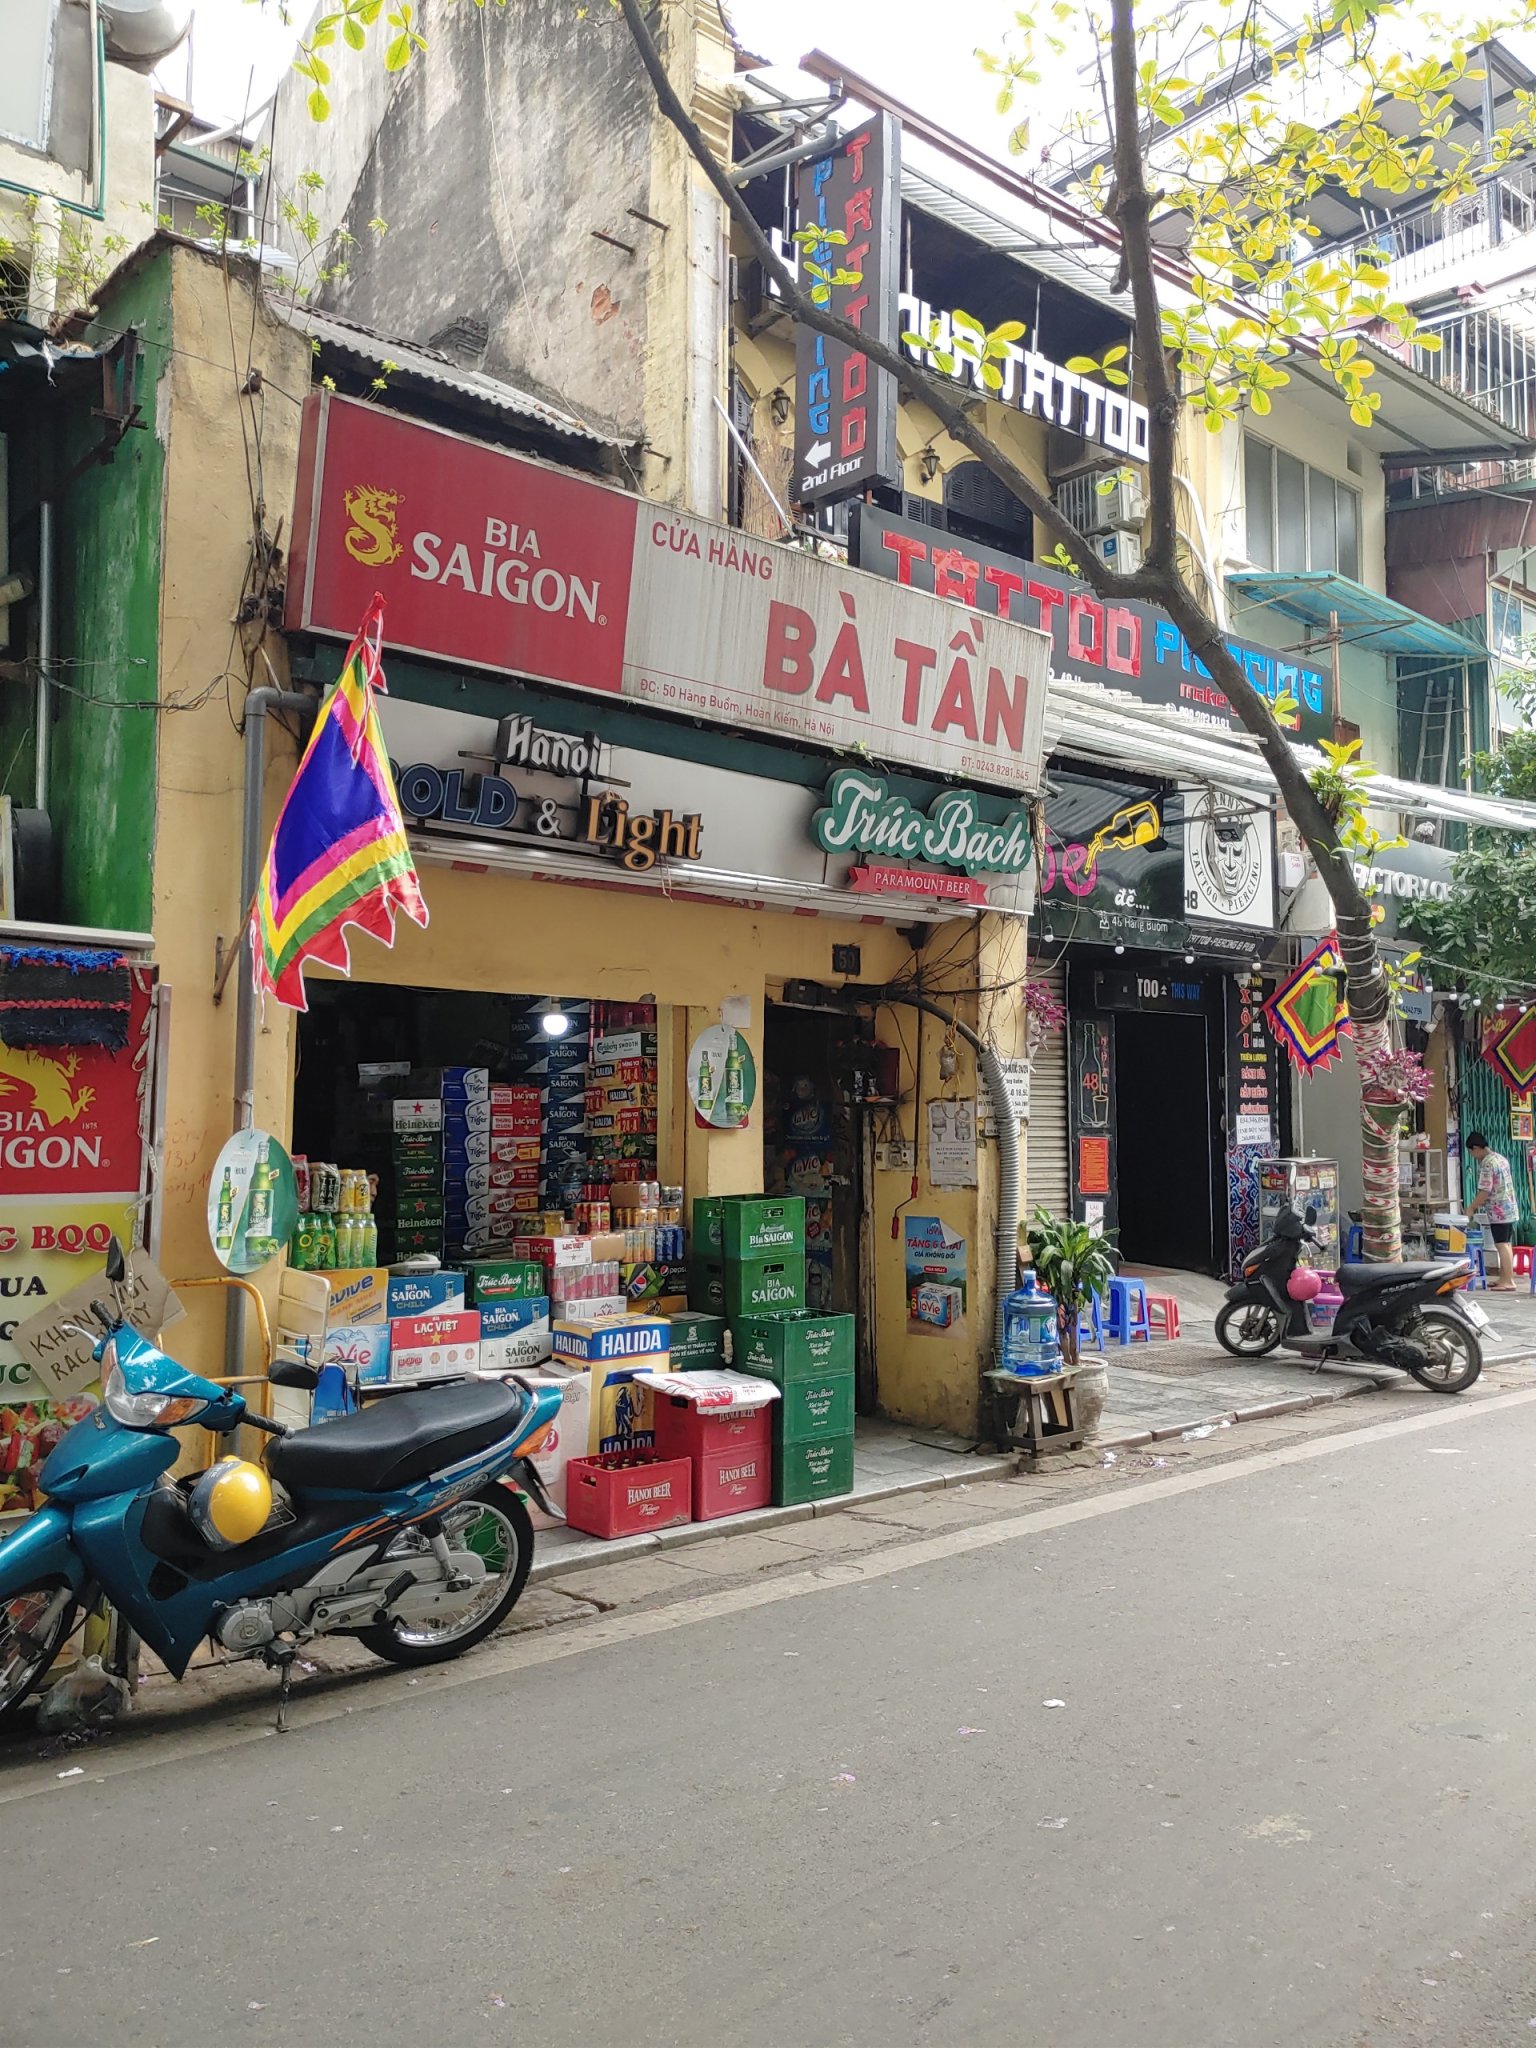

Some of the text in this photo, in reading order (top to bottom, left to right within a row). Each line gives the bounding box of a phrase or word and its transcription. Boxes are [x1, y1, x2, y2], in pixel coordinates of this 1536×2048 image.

[841, 132, 872, 459] TATTOO
[1003, 340, 1149, 462] TATTOO
[802, 456, 864, 491] 2nd Floor
[484, 516, 541, 559] BIA
[652, 517, 774, 580] CỬA HÀNG
[410, 531, 602, 624] SAIGON
[881, 529, 1142, 678] TATTOO
[763, 590, 1029, 754] BÀ TẦN
[640, 678, 835, 736] ĐC: 50 Hàng Buồm, Hoàn Kiếm, Hà Nội
[504, 713, 601, 777] Hanoi
[961, 756, 975, 768] ĐT:
[391, 758, 705, 872] OLD & Light
[824, 777, 1028, 875] Trúc Bạch
[873, 871, 971, 895] PARAMOUNT BEER
[1192, 848, 1259, 911] TATTOO PIERCING
[1353, 863, 1430, 899] ACTORY
[839, 950, 856, 970] 50
[1137, 979, 1201, 1000] TOO THIS WAY
[618, 1040, 639, 1049] SMOOTH
[469, 1084, 485, 1094] Tiger
[1082, 1073, 1098, 1089] 48
[0, 1111, 98, 1132] BIA 1875
[471, 1116, 487, 1126] Tiger
[550, 1110, 577, 1118] SAIGON
[395, 1119, 440, 1129] Heineken
[471, 1149, 486, 1159] Tiger
[470, 1179, 486, 1189] Tiger
[397, 1217, 442, 1228] Heineken
[470, 1211, 486, 1221] Tiger
[31, 1223, 112, 1254] BQQ
[750, 1231, 793, 1245] Bia SAIGON
[907, 1237, 930, 1250] TẶNG
[932, 1240, 938, 1248] 6
[925, 1251, 944, 1259] KHÔNG
[945, 1251, 956, 1259] ĐỔI
[670, 1267, 687, 1275] pepsi
[477, 1275, 498, 1288] Trúc
[767, 1279, 780, 1287] BIA
[391, 1290, 432, 1302] SAIGON
[752, 1286, 795, 1304] SAIGON
[396, 1301, 425, 1309] CHILL
[919, 1301, 941, 1315] laVie
[482, 1312, 519, 1325] SAIGON
[30, 1308, 97, 1358] KHÔN
[414, 1320, 458, 1336] LẠC VIỆT
[487, 1324, 513, 1332] CHILL
[505, 1345, 540, 1358] SAIGON
[556, 1329, 663, 1357] HALIDA HALIDA
[50, 1346, 90, 1381] RÁC
[508, 1356, 537, 1364] LAGER
[603, 1436, 654, 1453] HALIDA
[719, 1462, 756, 1486] HANOI BEER
[627, 1482, 672, 1505] HANOI BEER
